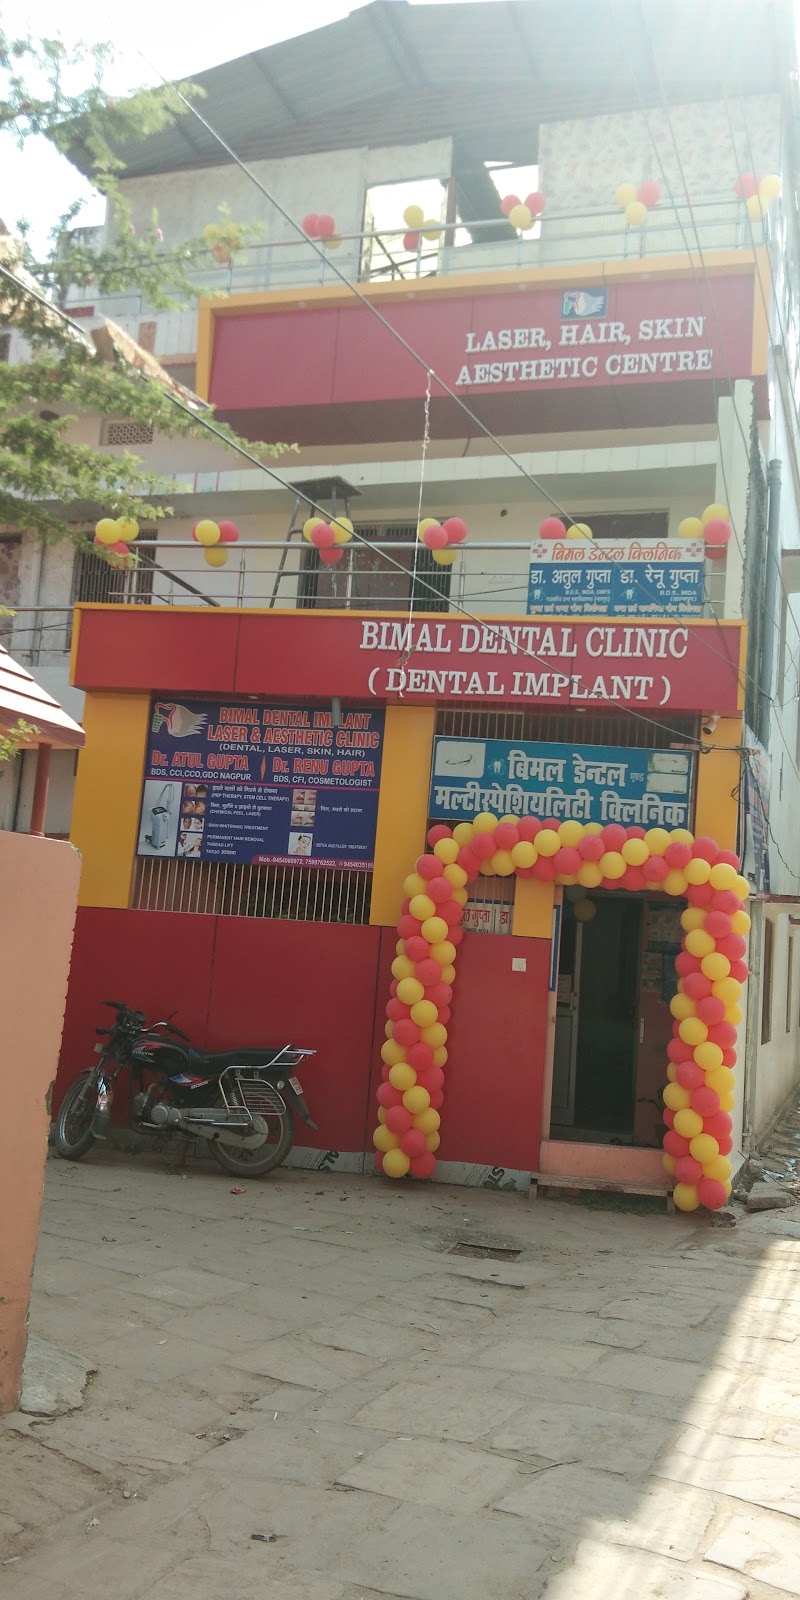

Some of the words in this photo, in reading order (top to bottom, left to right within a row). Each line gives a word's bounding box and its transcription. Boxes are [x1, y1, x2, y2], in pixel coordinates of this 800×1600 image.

[466, 327, 552, 352] LASER,
[559, 322, 631, 346] HAIR,
[638, 316, 705, 340] SKIN
[456, 356, 598, 386] AESTHETIC
[605, 350, 712, 376] CENTRE
[552, 570, 582, 590] अतुल
[585, 570, 612, 590] गुप्ता
[644, 564, 666, 590] रेनू
[668, 570, 700, 590] गुप्ता
[360, 620, 452, 653] BIMAL
[458, 624, 578, 658] DENTAL
[586, 627, 689, 659] CLINIC
[219, 706, 260, 724] BIMAL
[262, 708, 310, 728] DENTAL
[313, 712, 372, 730] IMLANT
[207, 724, 248, 743] LASER
[250, 726, 261, 744] &
[263, 728, 334, 748] AESTHETIC
[335, 730, 380, 749] CLINIC
[152, 750, 168, 766] Dr.
[172, 752, 204, 769] ATUL
[206, 753, 250, 772] GUPTA
[219, 743, 266, 753] (DENTAL,
[268, 745, 304, 754] LASER,
[306, 748, 334, 757] SKIN,
[336, 748, 366, 758] HAIR)
[151, 768, 168, 777] BDS,
[220, 772, 252, 780] NAGPUR
[272, 756, 290, 774] Dr.
[292, 758, 330, 776] RENU
[332, 760, 376, 777] GUPTA
[506, 750, 567, 784] बिमल
[572, 752, 628, 788] डेन्टल
[273, 774, 291, 784] BDS,
[292, 776, 306, 784] CFI,
[308, 776, 372, 786] COSMETOLOGIST
[600, 790, 688, 826] क्लिनिक
